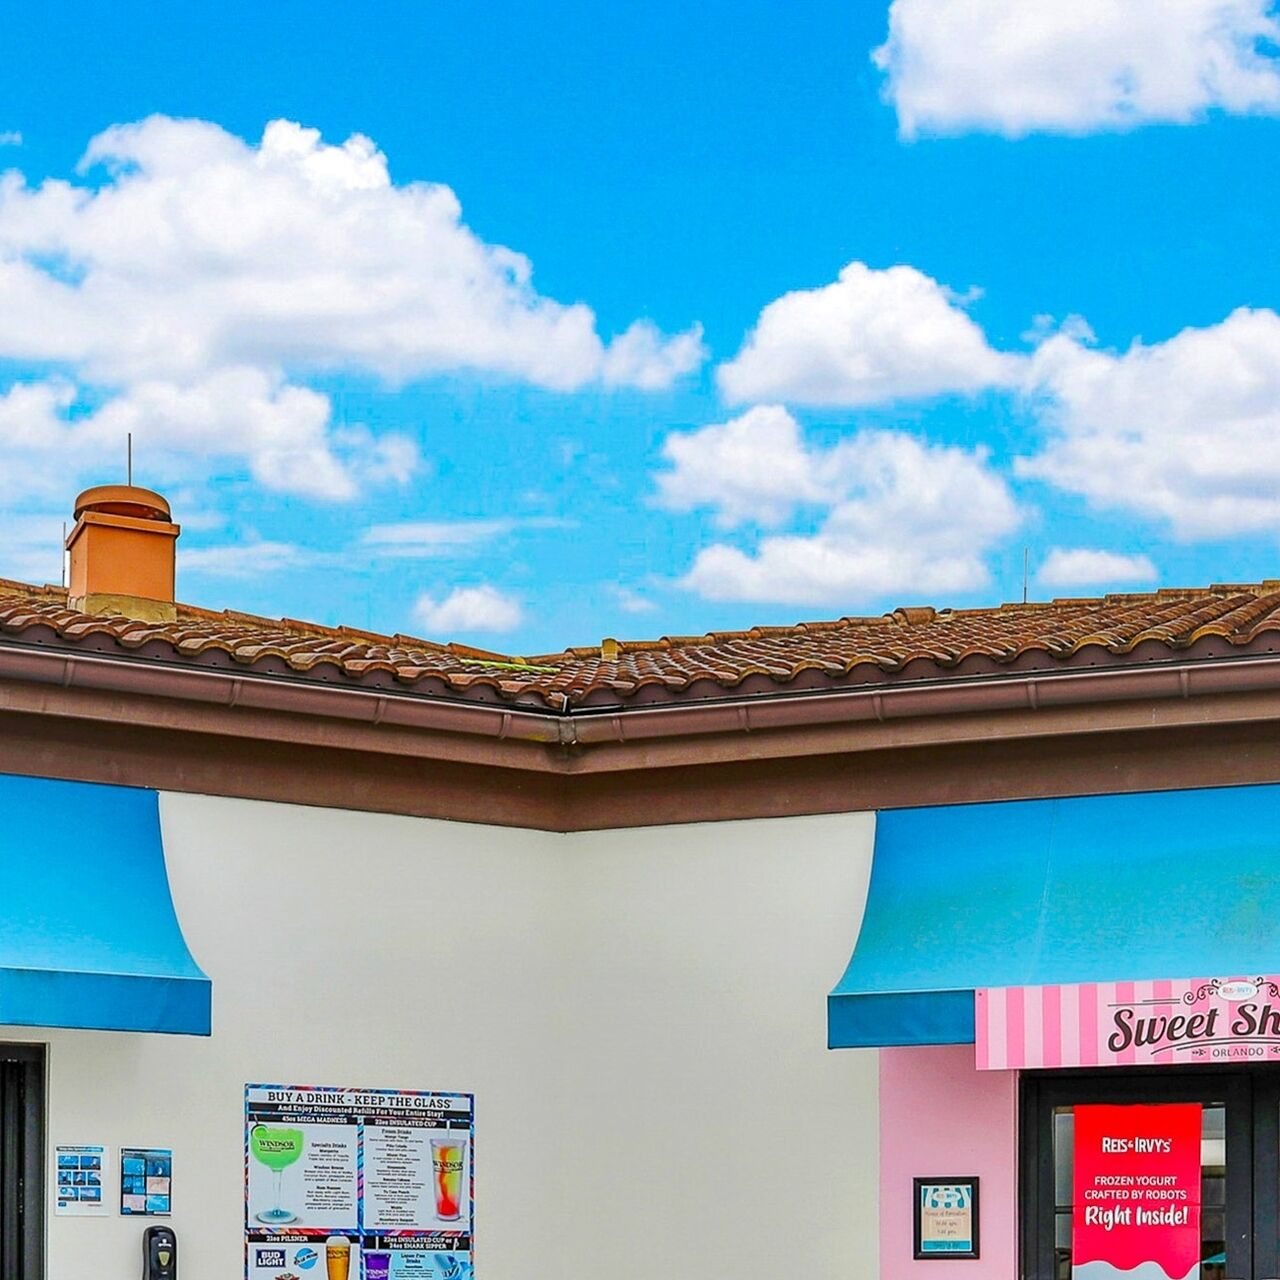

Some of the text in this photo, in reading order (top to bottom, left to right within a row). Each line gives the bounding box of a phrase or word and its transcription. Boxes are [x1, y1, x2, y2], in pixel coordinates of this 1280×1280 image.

[1107, 1008, 1220, 1053] Sweet
[1212, 1047, 1264, 1058] ORLANDO
[268, 1092, 293, 1102] BUY
[296, 1093, 305, 1102] A
[306, 1093, 345, 1104] DRINK
[354, 1095, 385, 1105] KEEP
[388, 1096, 412, 1107] THE
[277, 1104, 292, 1112] And
[293, 1105, 313, 1113] Enjoy
[314, 1106, 352, 1114] Discounted
[427, 1110, 444, 1119] Stay!
[389, 1119, 423, 1127] INSULATED
[258, 1140, 295, 1148] WINDSOR
[1094, 1176, 1178, 1186] FROZEN YOGURT
[1084, 1190, 1187, 1200] CRAFTED BY ROBOTS
[1085, 1203, 1189, 1231] Right Inside!
[261, 1251, 281, 1259] BUD
[258, 1258, 284, 1266] LIGHT
